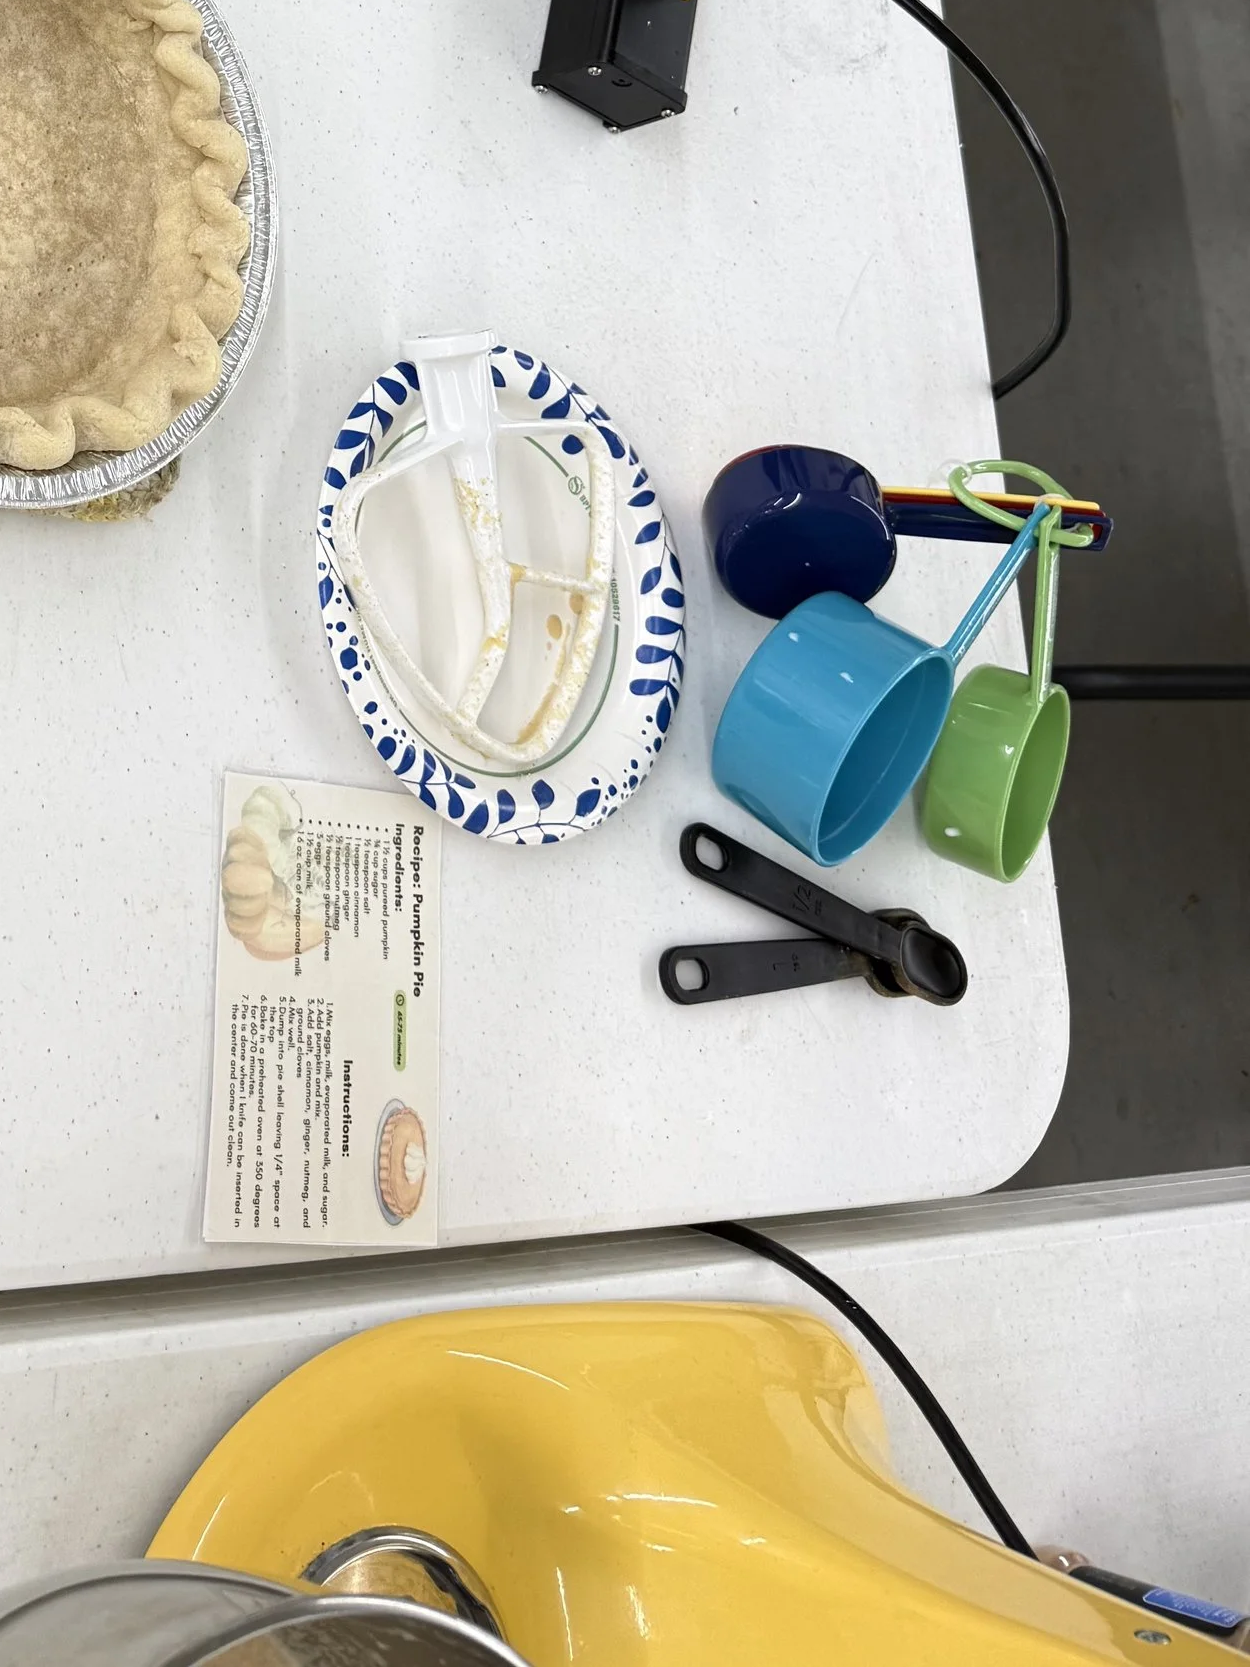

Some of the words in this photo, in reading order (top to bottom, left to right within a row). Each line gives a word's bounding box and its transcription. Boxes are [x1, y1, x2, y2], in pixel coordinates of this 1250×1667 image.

[304, 849, 312, 868] cup
[314, 842, 322, 865] eggs
[323, 846, 332, 891] teaspoon
[333, 847, 341, 891] teaspoon
[343, 842, 351, 887] teaspoon
[352, 843, 361, 888] teaspoon
[393, 823, 405, 912] Ingredients:
[410, 825, 424, 888] Recipe:
[362, 850, 370, 894] teaspoon
[371, 871, 379, 898] sugar
[296, 884, 303, 894] of
[381, 883, 389, 916] pureed
[323, 893, 332, 928] ground
[333, 894, 341, 931] nutmeg
[343, 890, 351, 921] ginger
[293, 897, 302, 954] evaporated
[381, 919, 389, 960] pumpkin
[410, 894, 424, 966] Pumpkin
[413, 972, 424, 997] Pie
[231, 1004, 239, 1020] the
[250, 1005, 259, 1020] for
[277, 1007, 286, 1036] Dump
[296, 1008, 304, 1043] ground
[307, 1008, 315, 1029] Add
[316, 1009, 324, 1030] Add
[240, 1035, 248, 1061] done
[260, 1035, 266, 1043] in
[287, 1028, 295, 1051] well.
[305, 1035, 314, 1056] salt,
[314, 1032, 323, 1075] pumpkin
[257, 1059, 266, 1112] preheated
[276, 1064, 284, 1081] pie
[304, 1061, 312, 1113] cinnamon,
[324, 1060, 332, 1082] milk,
[238, 1103, 247, 1127] knife
[314, 1101, 322, 1120] mix.
[322, 1085, 331, 1144] evaporated
[342, 1060, 353, 1157] Instructions:
[274, 1112, 284, 1149] leaving
[303, 1119, 312, 1155] ginger,
[227, 1135, 235, 1167] clean.
[237, 1155, 244, 1168] be
[256, 1145, 262, 1156] at
[322, 1148, 331, 1170] milk,
[255, 1161, 263, 1180] 350
[301, 1160, 310, 1202] nutmeg,
[235, 1172, 243, 1214] inserted
[252, 1184, 263, 1228] degrees
[273, 1180, 281, 1212] space
[235, 1218, 241, 1228] in
[274, 1217, 280, 1228] at
[303, 1208, 311, 1228] and
[320, 1196, 329, 1228] sugar.
